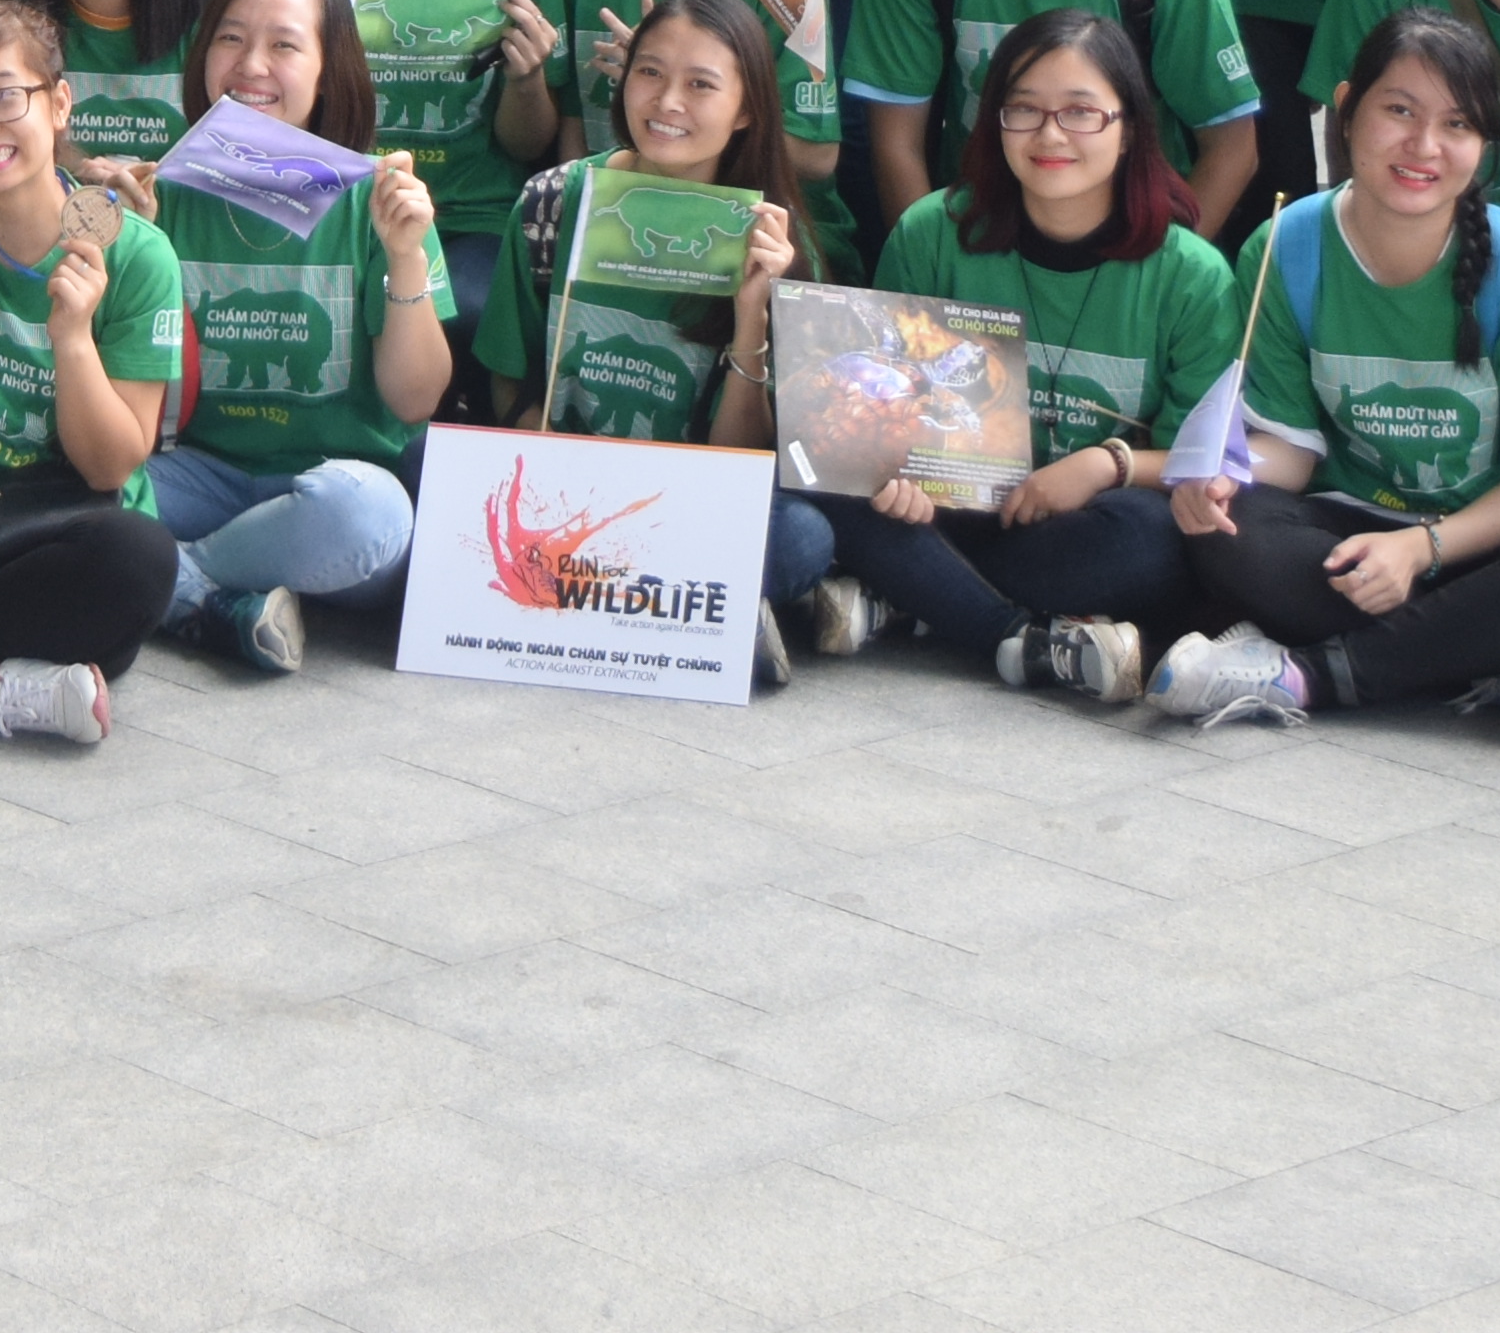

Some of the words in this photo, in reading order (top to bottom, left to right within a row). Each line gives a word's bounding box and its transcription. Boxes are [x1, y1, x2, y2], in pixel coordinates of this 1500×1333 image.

[948, 482, 973, 496] 1522
[558, 554, 598, 578] RUN
[602, 564, 628, 578] FOR
[554, 577, 727, 624] WILDLIFE
[445, 633, 483, 649] HÀNH
[506, 657, 545, 671] ACTION
[547, 660, 594, 676] AGAINST
[593, 664, 657, 682] EXTINCTION
